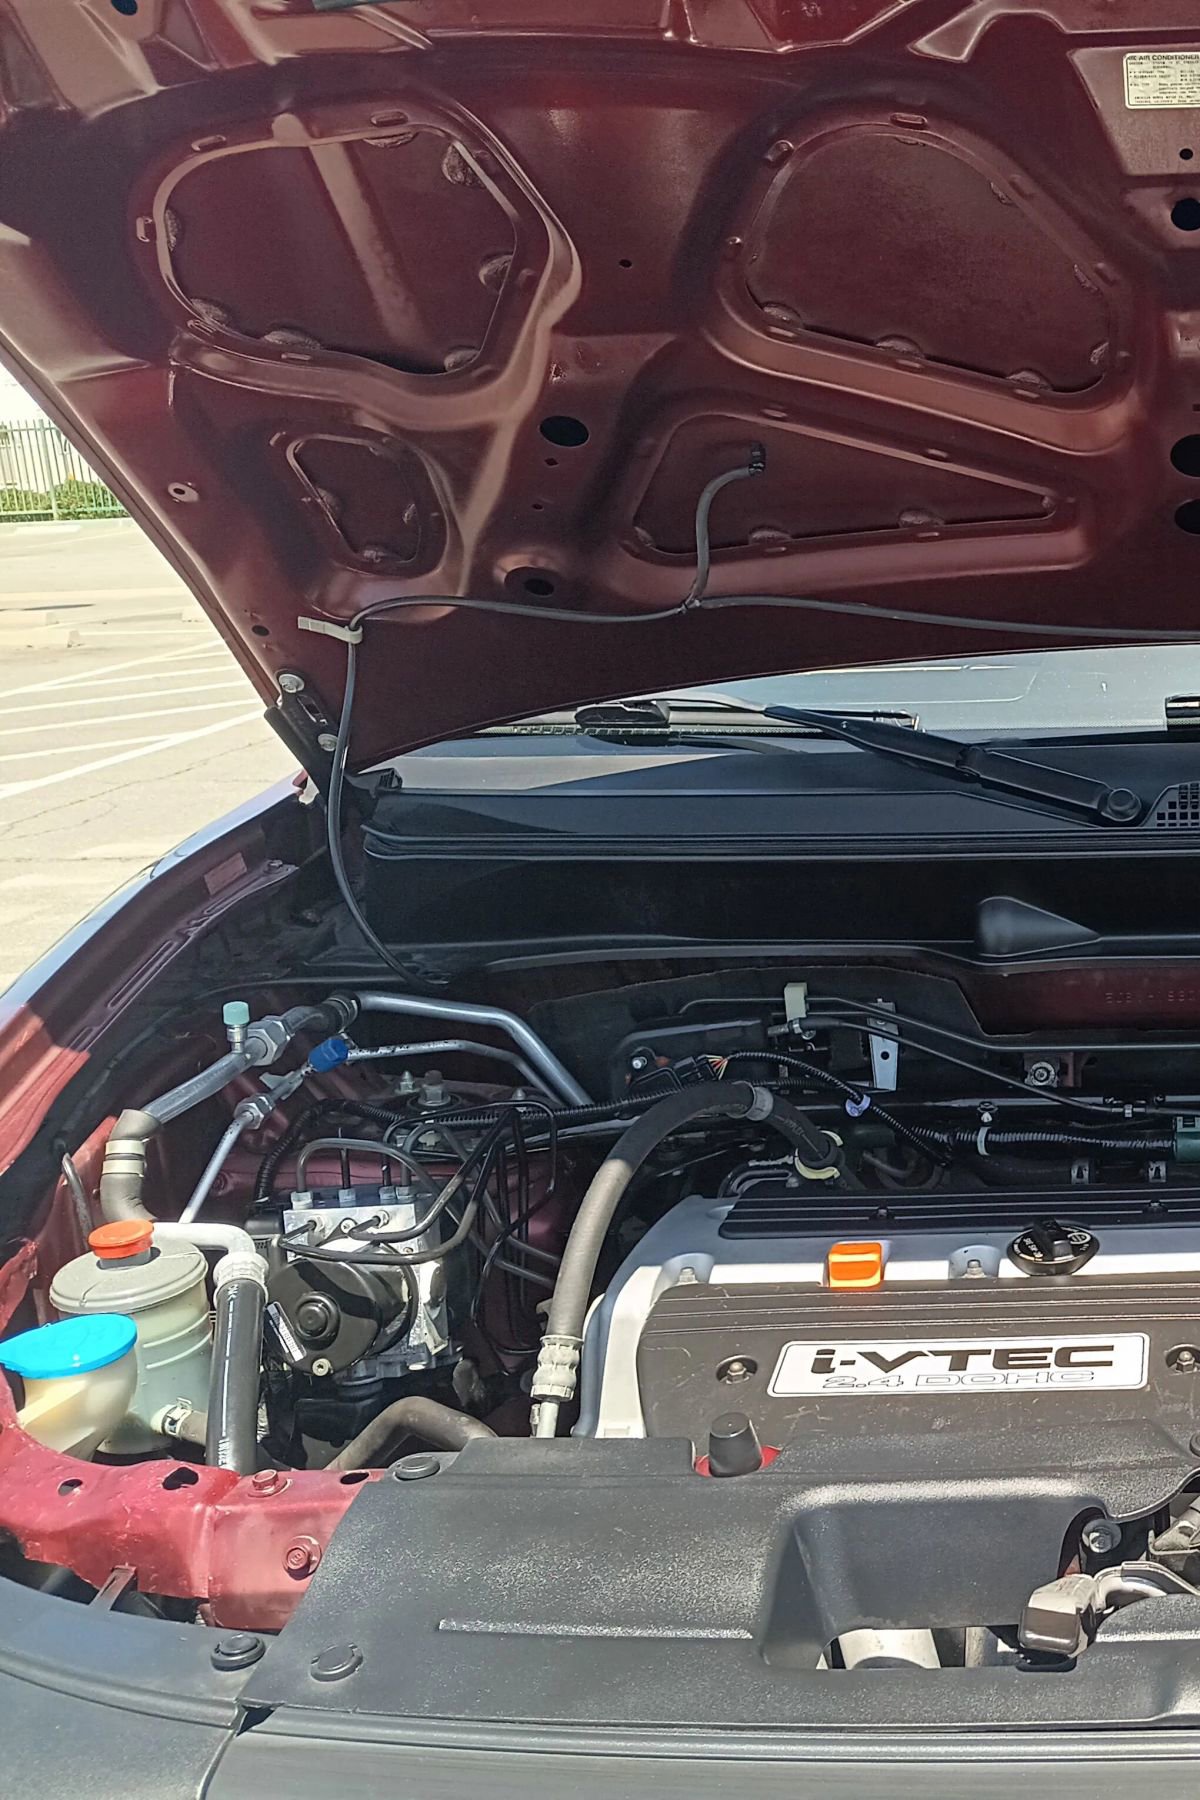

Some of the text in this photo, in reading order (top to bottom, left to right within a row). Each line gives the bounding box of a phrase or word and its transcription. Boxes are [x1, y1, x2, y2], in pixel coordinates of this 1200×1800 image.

[811, 1345, 1114, 1375] i-VTEC
[822, 1370, 1096, 1388] 2.4 DOHC
